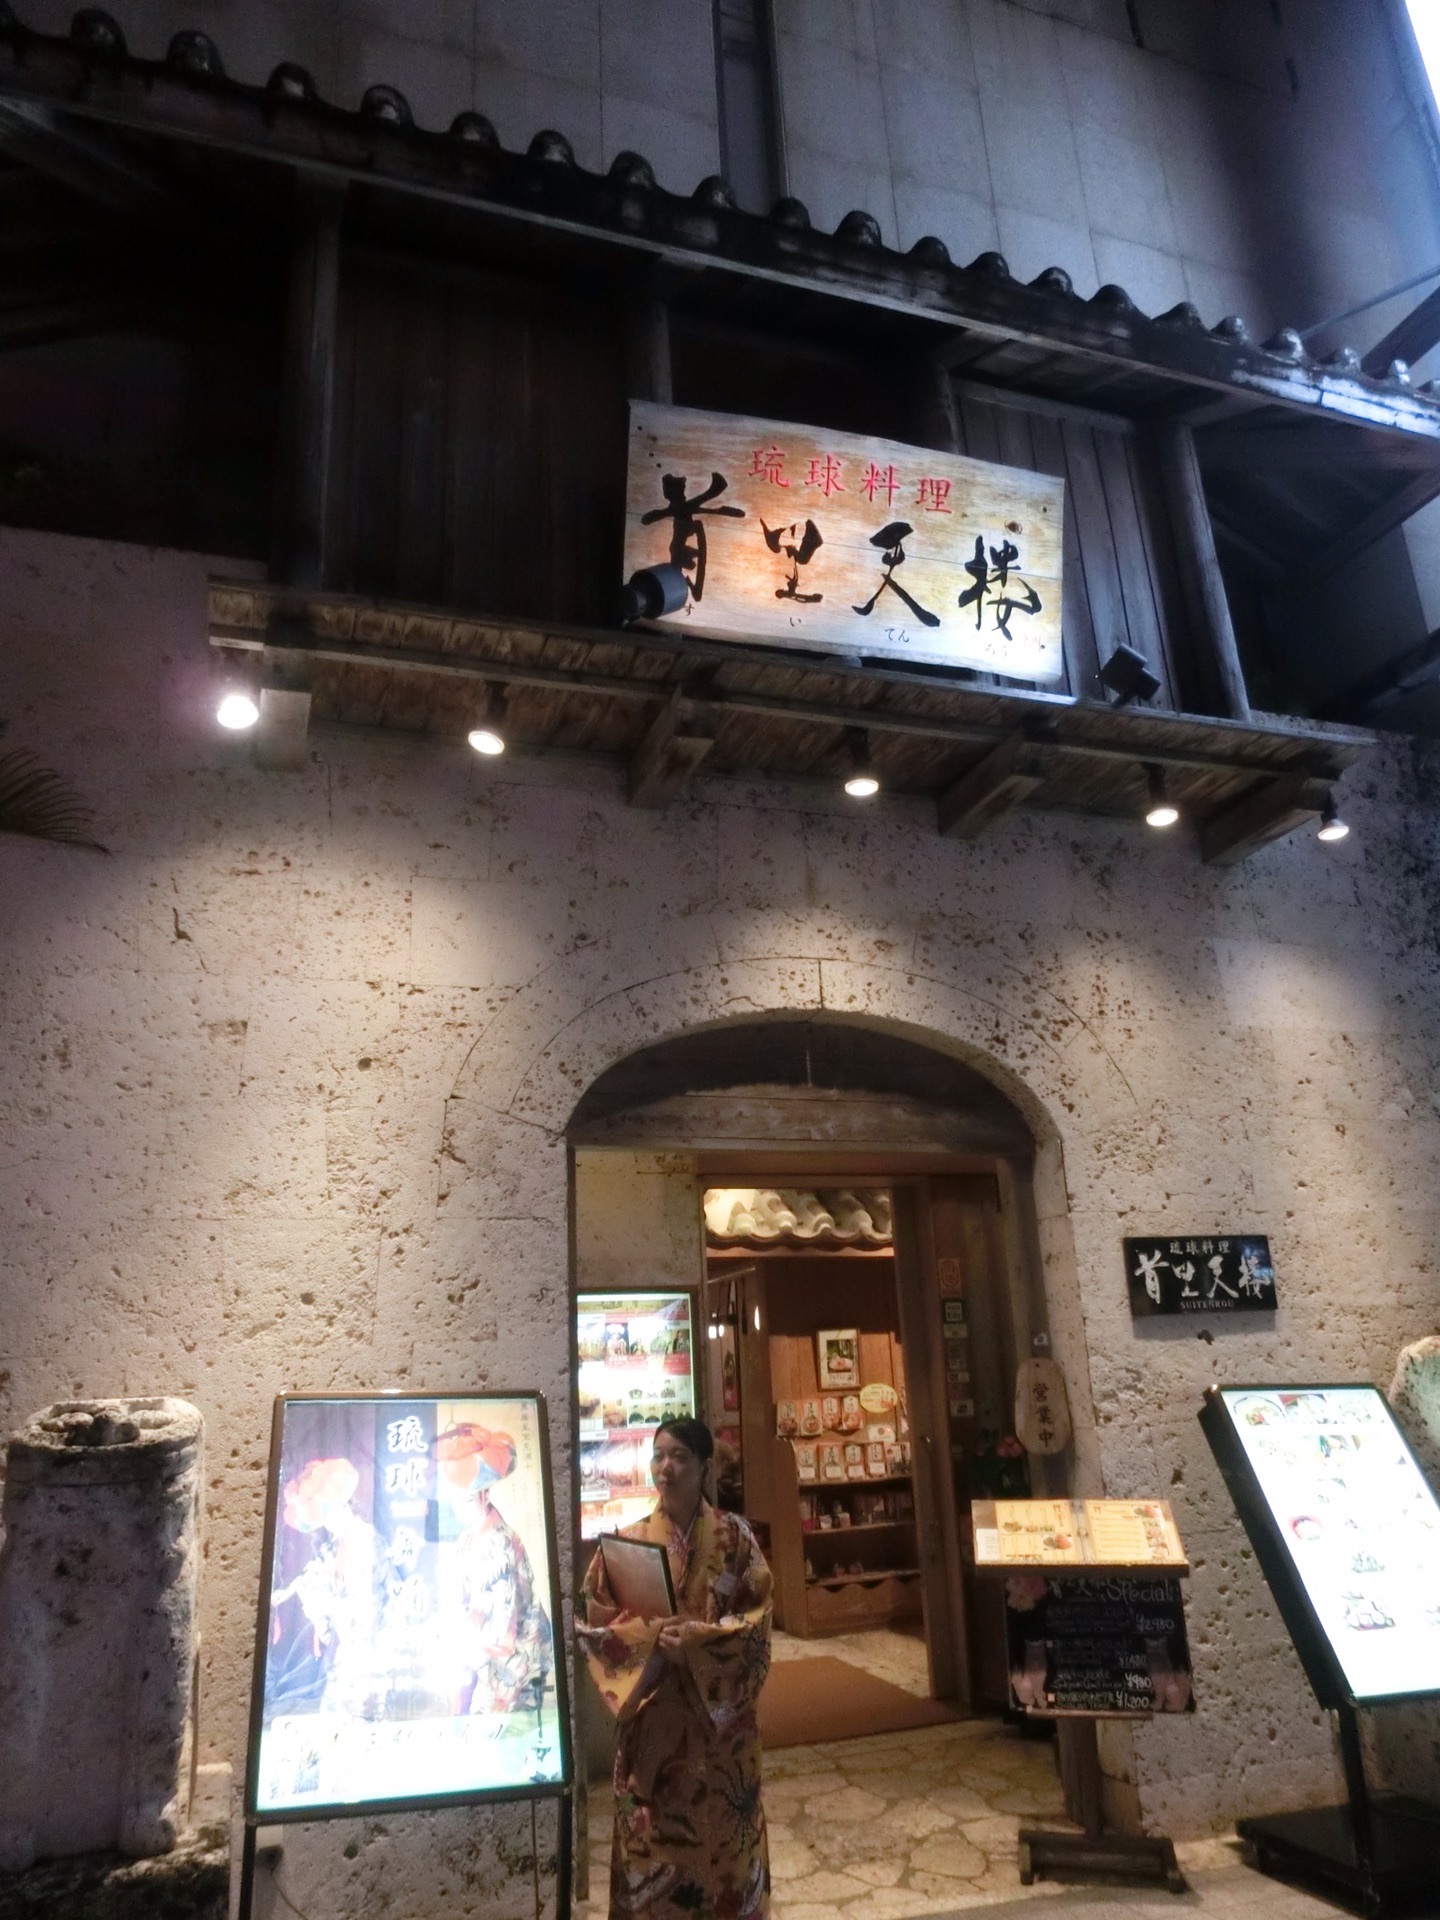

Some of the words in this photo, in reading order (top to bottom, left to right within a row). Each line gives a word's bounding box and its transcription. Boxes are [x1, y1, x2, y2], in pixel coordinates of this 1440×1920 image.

[748, 444, 953, 515] 琉球料理
[641, 472, 1043, 641] 首里天楼
[1169, 1240, 1232, 1255] 琉球料理
